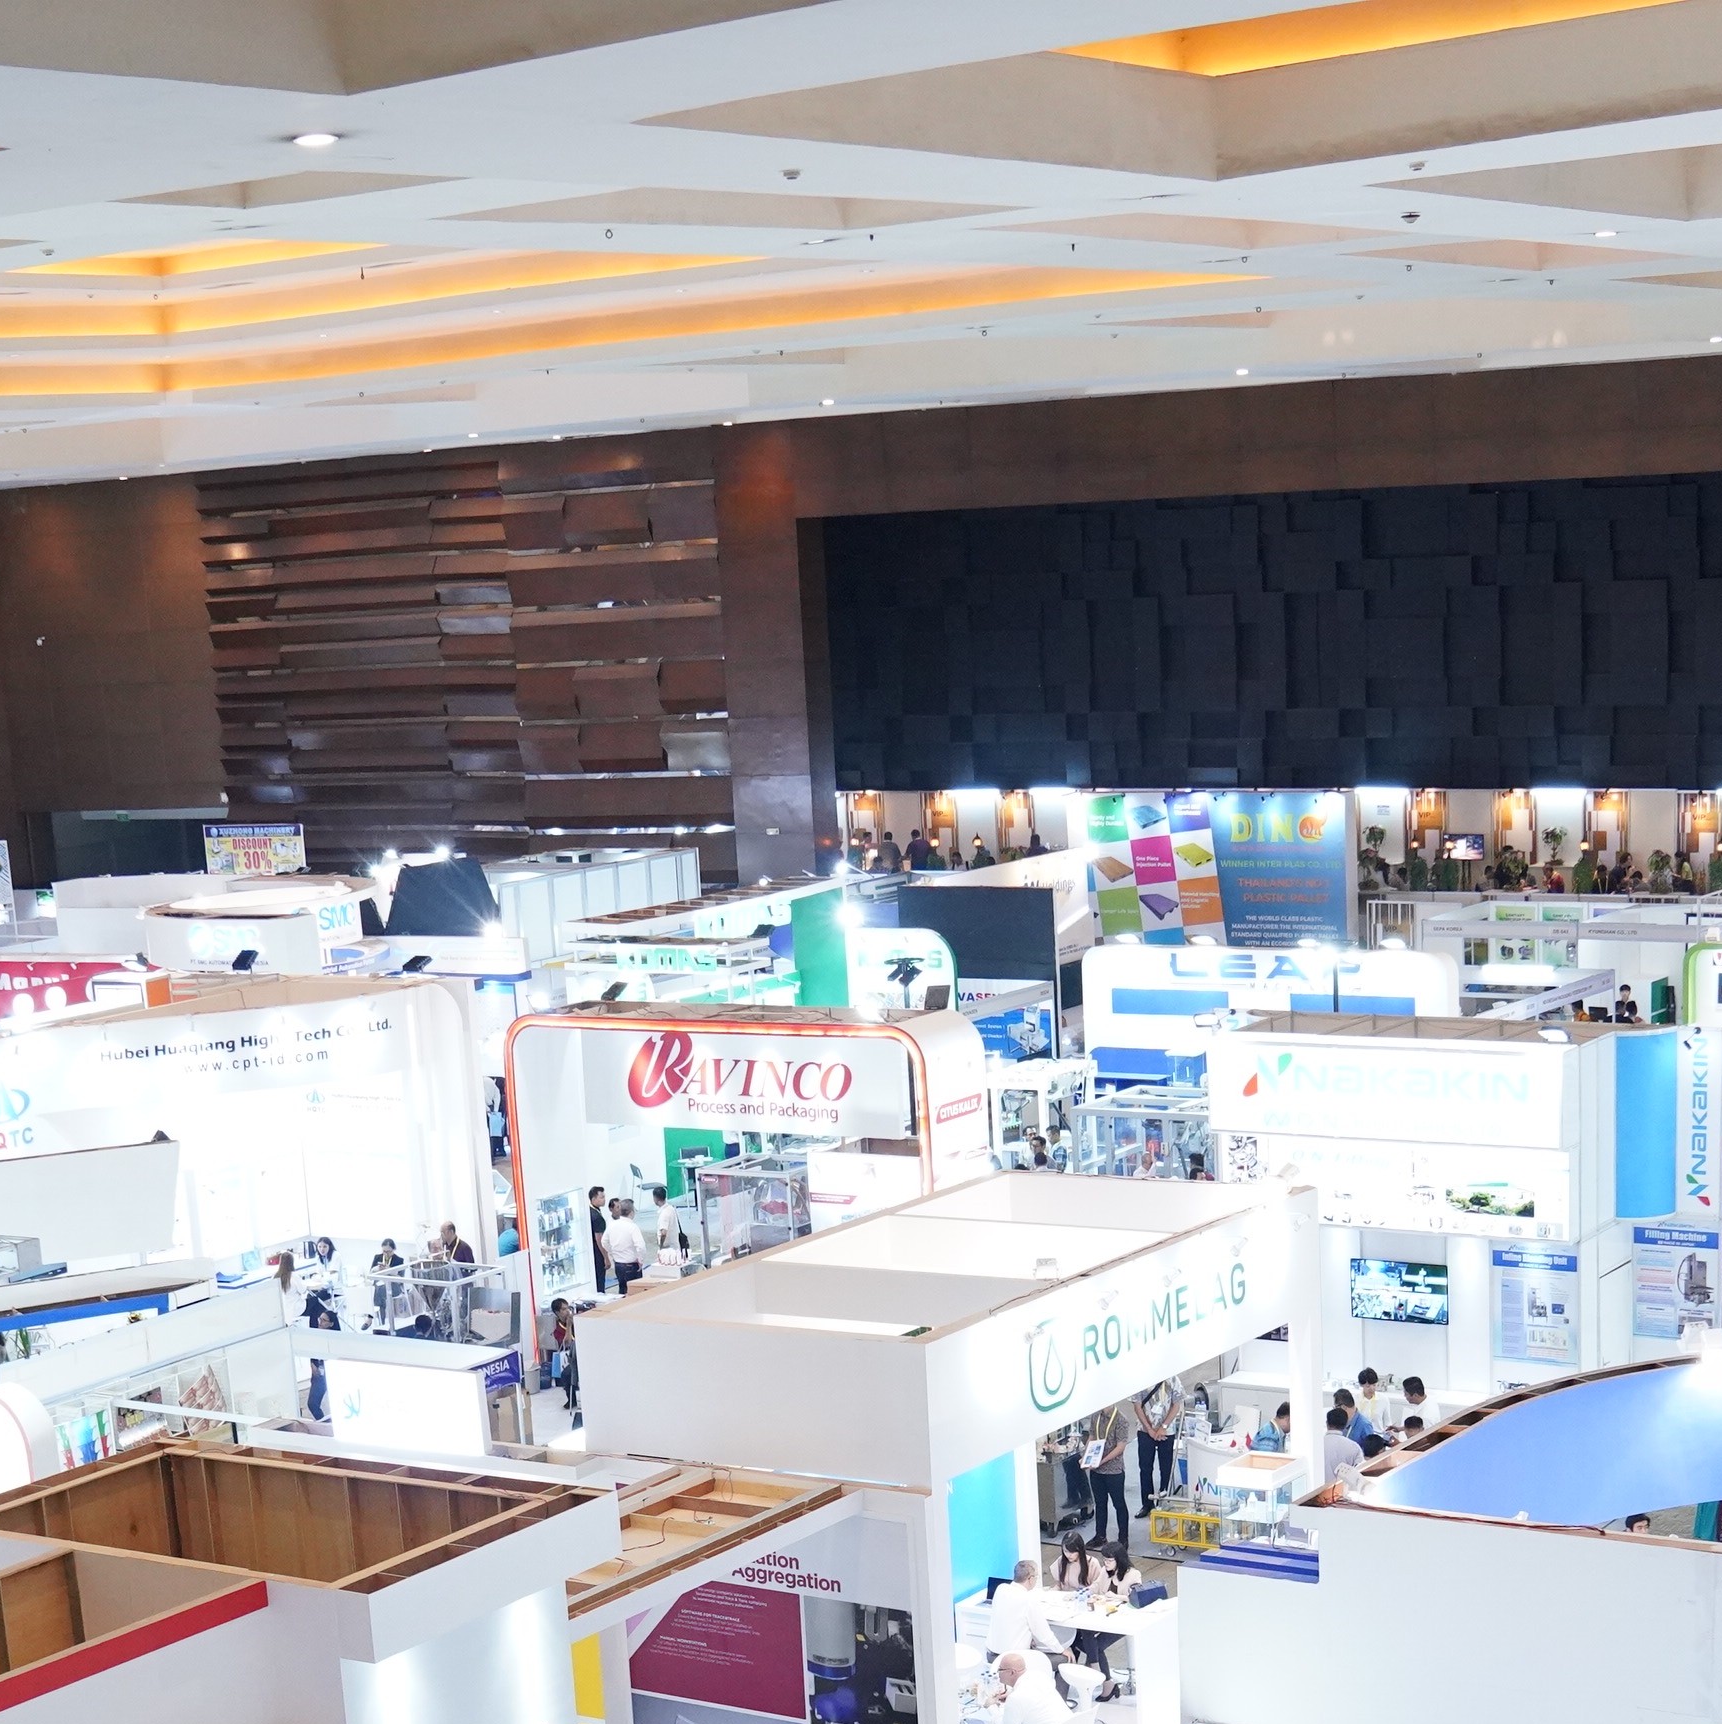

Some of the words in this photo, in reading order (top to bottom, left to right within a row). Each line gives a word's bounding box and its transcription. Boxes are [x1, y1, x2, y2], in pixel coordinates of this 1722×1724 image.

[232, 837, 272, 850] DISCOUNT
[244, 851, 272, 869] 30%
[319, 903, 355, 930] SMC
[100, 1044, 150, 1062] Hubei
[154, 1035, 236, 1059] Huaqiang
[294, 1027, 331, 1042] Tech
[368, 1018, 392, 1033] Ltd.
[627, 1031, 852, 1108] RAVINCO
[688, 1097, 736, 1115] Process
[739, 1100, 765, 1115] and
[769, 1101, 839, 1123] Packaging
[1645, 1229, 1670, 1241] Filling
[1672, 1230, 1707, 1243] Machine
[732, 1566, 841, 1593] Aggregation
